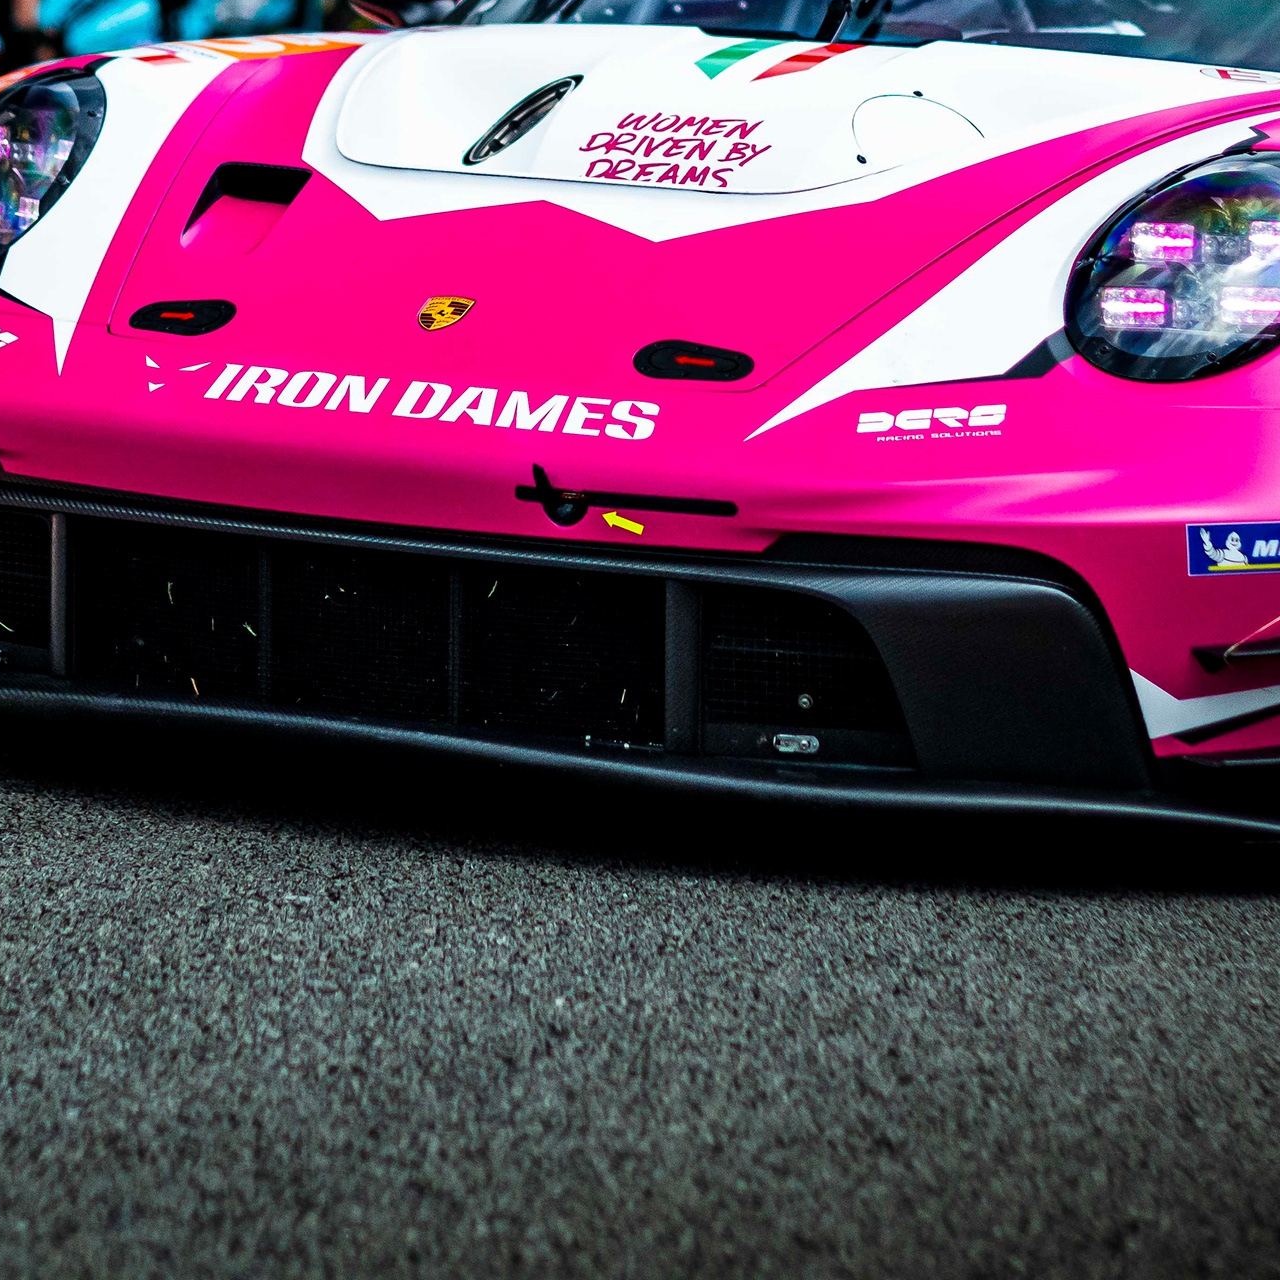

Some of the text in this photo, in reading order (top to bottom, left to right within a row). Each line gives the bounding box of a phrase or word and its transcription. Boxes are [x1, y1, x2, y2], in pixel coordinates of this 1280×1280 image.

[616, 112, 764, 139] WOMEN
[579, 132, 772, 167] DRIVEN BY
[585, 158, 734, 188] DREAMS
[203, 363, 661, 440] IRON DAMES
[876, 429, 1002, 442] RACING SOLUTIONS
